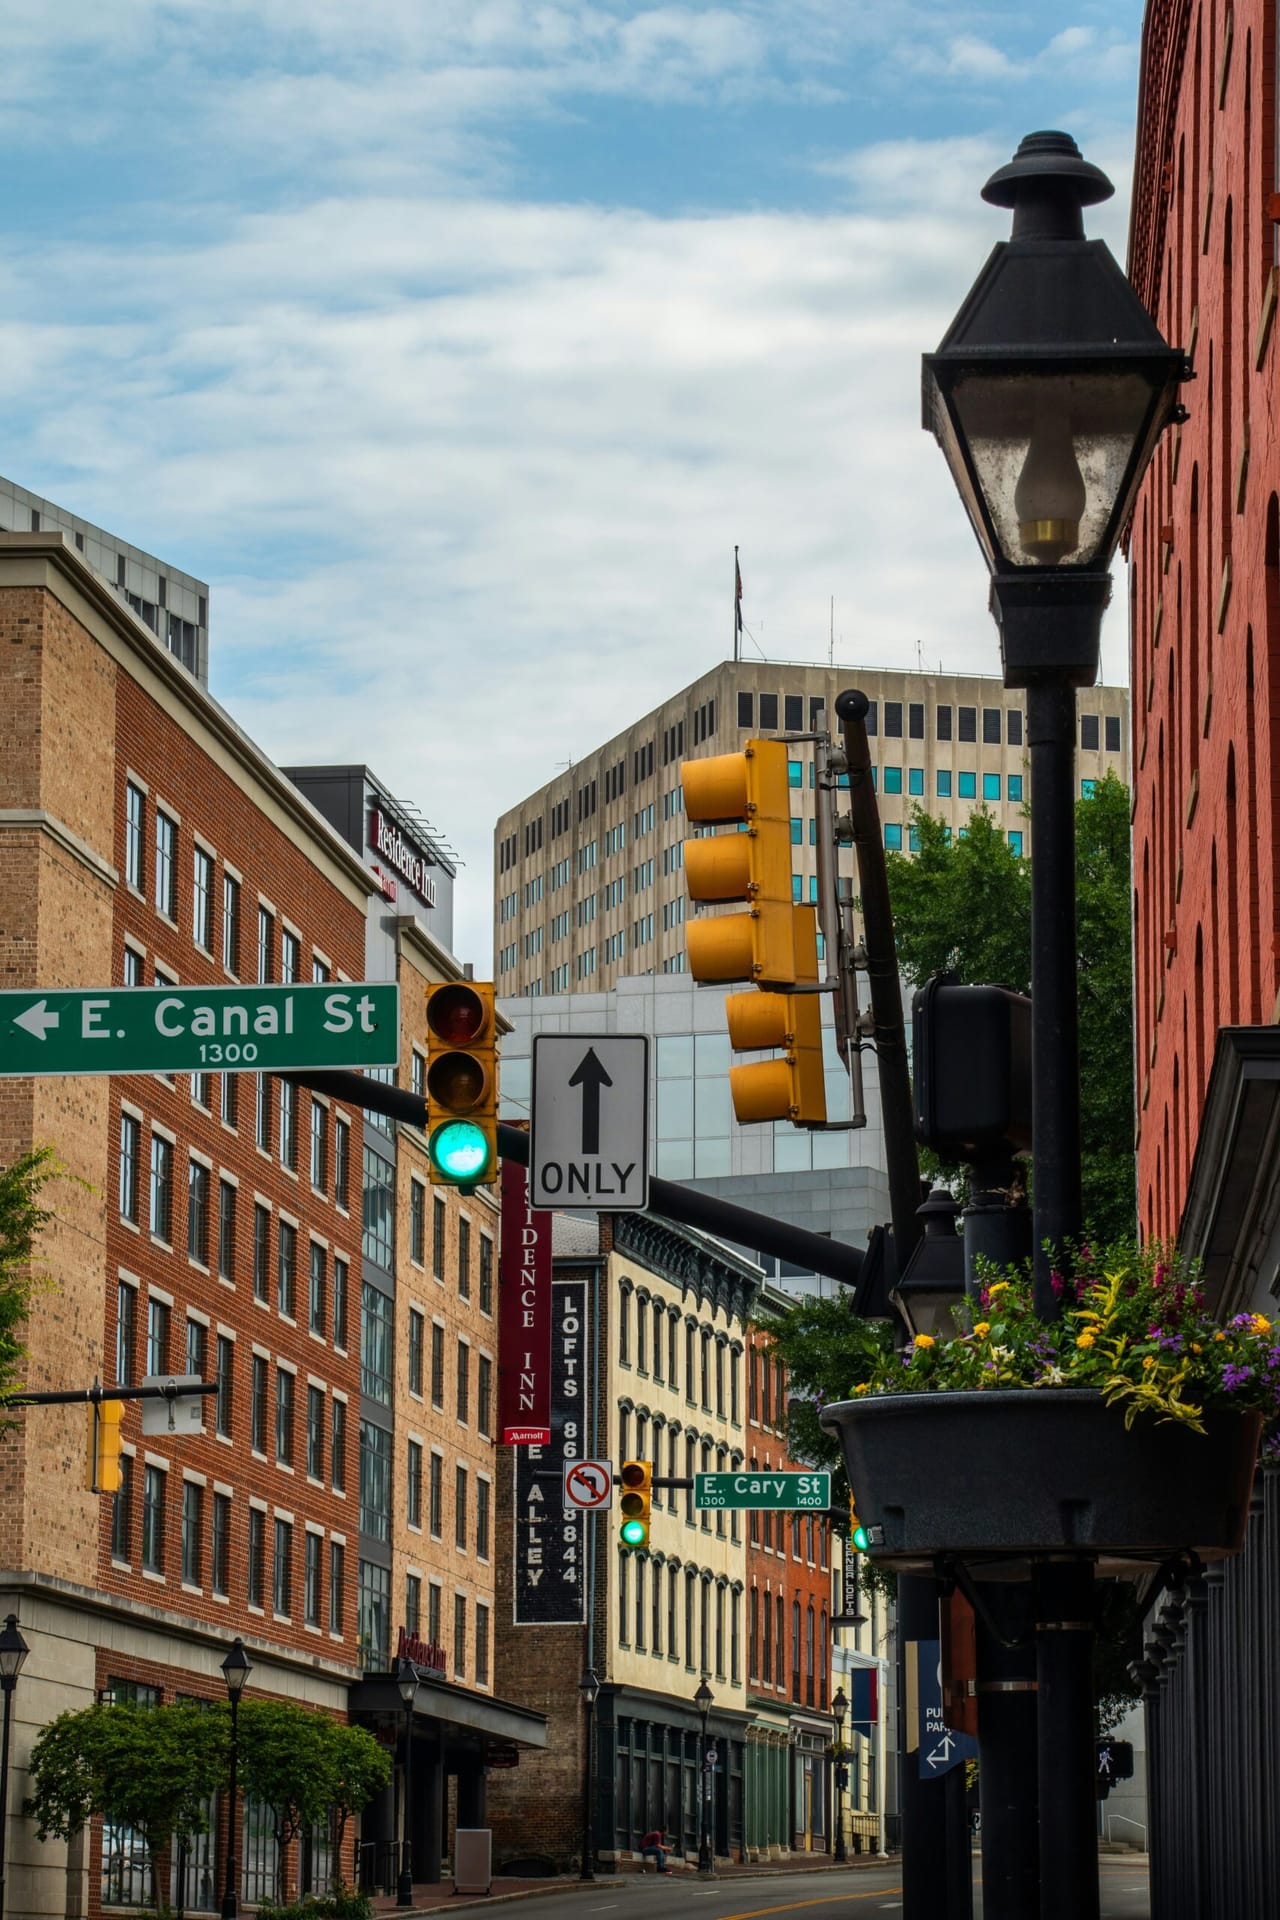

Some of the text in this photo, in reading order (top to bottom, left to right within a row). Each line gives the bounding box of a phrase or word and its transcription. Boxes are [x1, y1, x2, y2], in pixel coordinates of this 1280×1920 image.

[376, 810, 422, 890] Residence
[421, 858, 437, 908] Inn
[81, 993, 376, 1039] E. Canal St
[199, 1042, 259, 1064] 1300
[541, 1162, 637, 1194] ONLY
[562, 1295, 580, 1398] LOFTS
[519, 1352, 537, 1412] INN
[510, 1432, 544, 1441] Marriott
[699, 1496, 822, 1506] 1300 1400
[703, 1476, 820, 1499] E. Cary St
[526, 1483, 545, 1587] ALLEY
[845, 1580, 855, 1616] LOFTS
